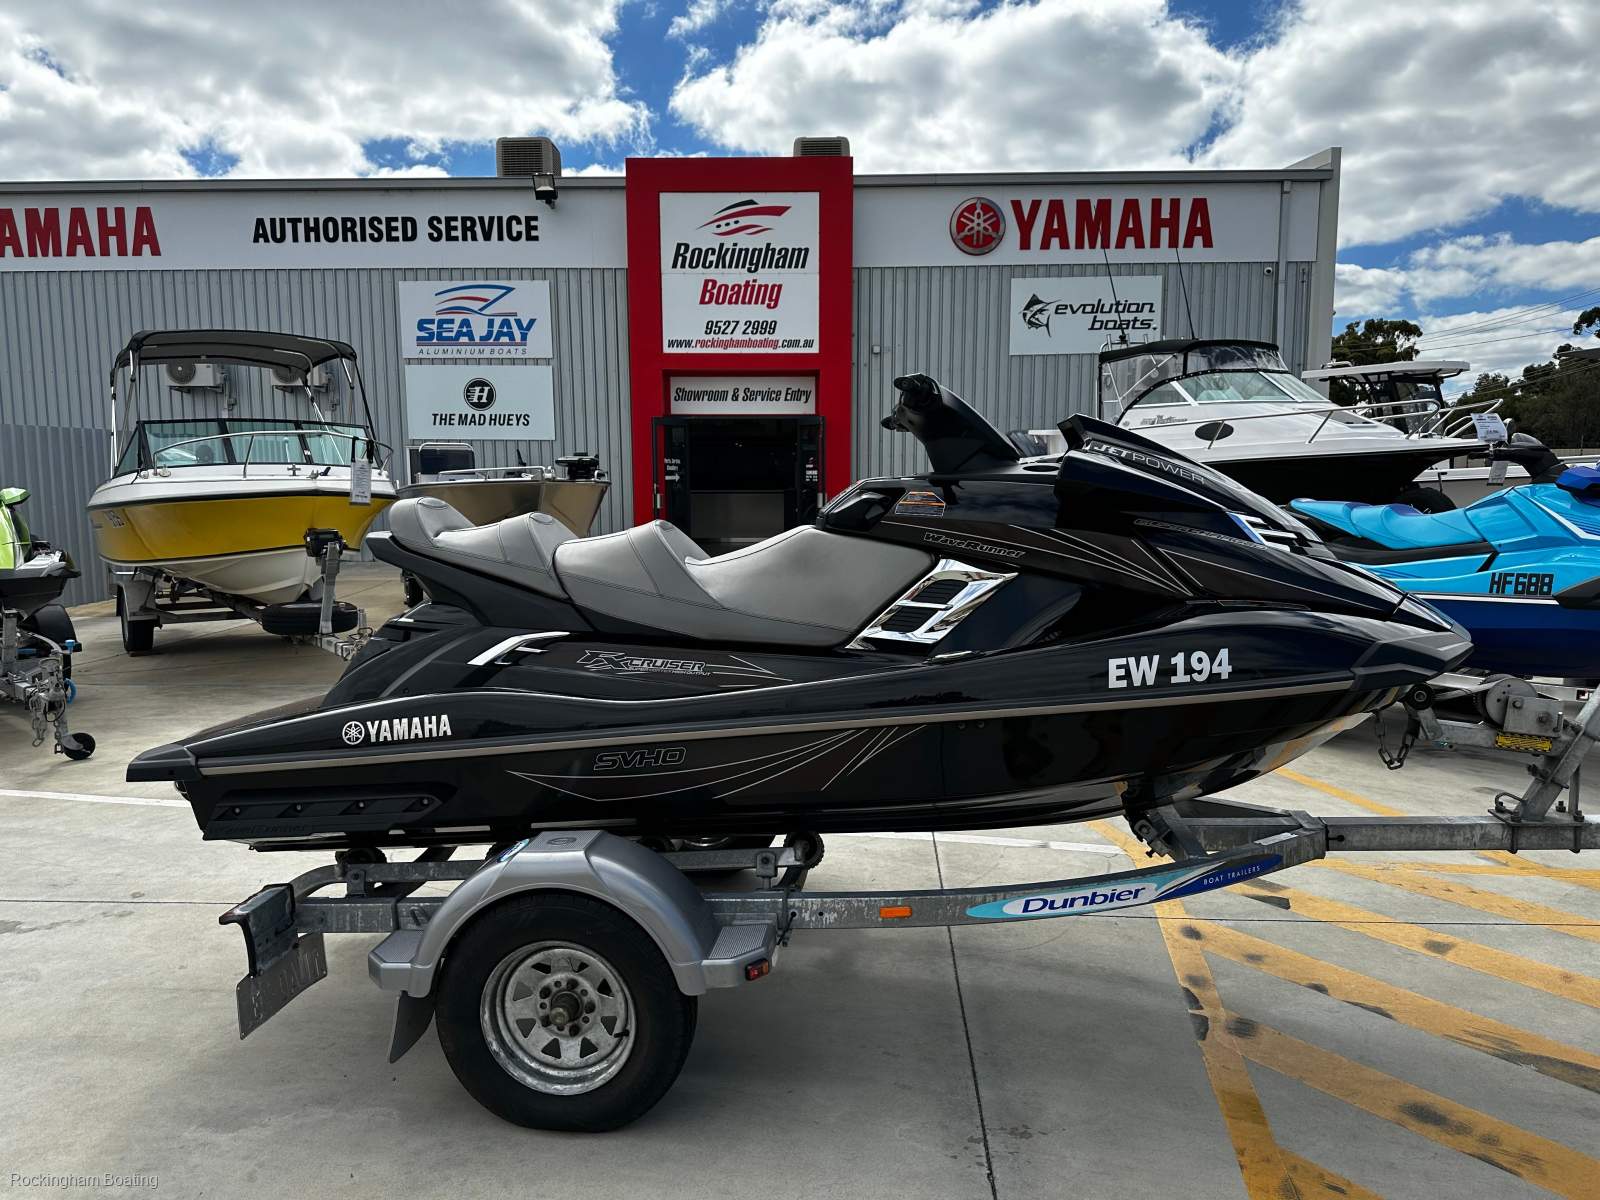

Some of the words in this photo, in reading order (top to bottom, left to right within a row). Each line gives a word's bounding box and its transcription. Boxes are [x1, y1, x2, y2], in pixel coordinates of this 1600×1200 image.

[0, 207, 161, 257] AMAHA
[252, 216, 418, 243] AUTHORISED
[427, 215, 540, 242] SERVICE
[1010, 198, 1214, 250] YAMAHA
[671, 242, 810, 273] Rockingham
[699, 278, 783, 309] Boating
[1054, 298, 1156, 315] evolution
[416, 318, 475, 342] SEA
[479, 318, 537, 342] JAY
[704, 320, 740, 335] 9527
[742, 320, 778, 335] 2999
[1088, 315, 1158, 331] boats.
[418, 347, 485, 355] ALUMINIUM
[489, 347, 527, 355] BOATS
[667, 337, 815, 350] www.rockinghamboating.com.au
[674, 386, 729, 402] Showroom
[731, 387, 740, 402] &
[742, 387, 782, 402] Service
[784, 387, 812, 404] Entry
[432, 413, 456, 426] THE
[457, 413, 487, 426] MAD
[488, 413, 531, 427] HUEYS
[923, 531, 1027, 559] WaveRunner
[1488, 572, 1555, 596] HF688
[628, 657, 706, 672] CRUISER
[1108, 654, 1160, 689] EW
[1170, 647, 1233, 684] 194
[366, 714, 452, 743] YAMAHA
[593, 746, 687, 771] SVHO
[1203, 874, 1224, 885] BOAT
[1227, 865, 1261, 879] TRAILERS
[1021, 886, 1147, 914] Dunbier
